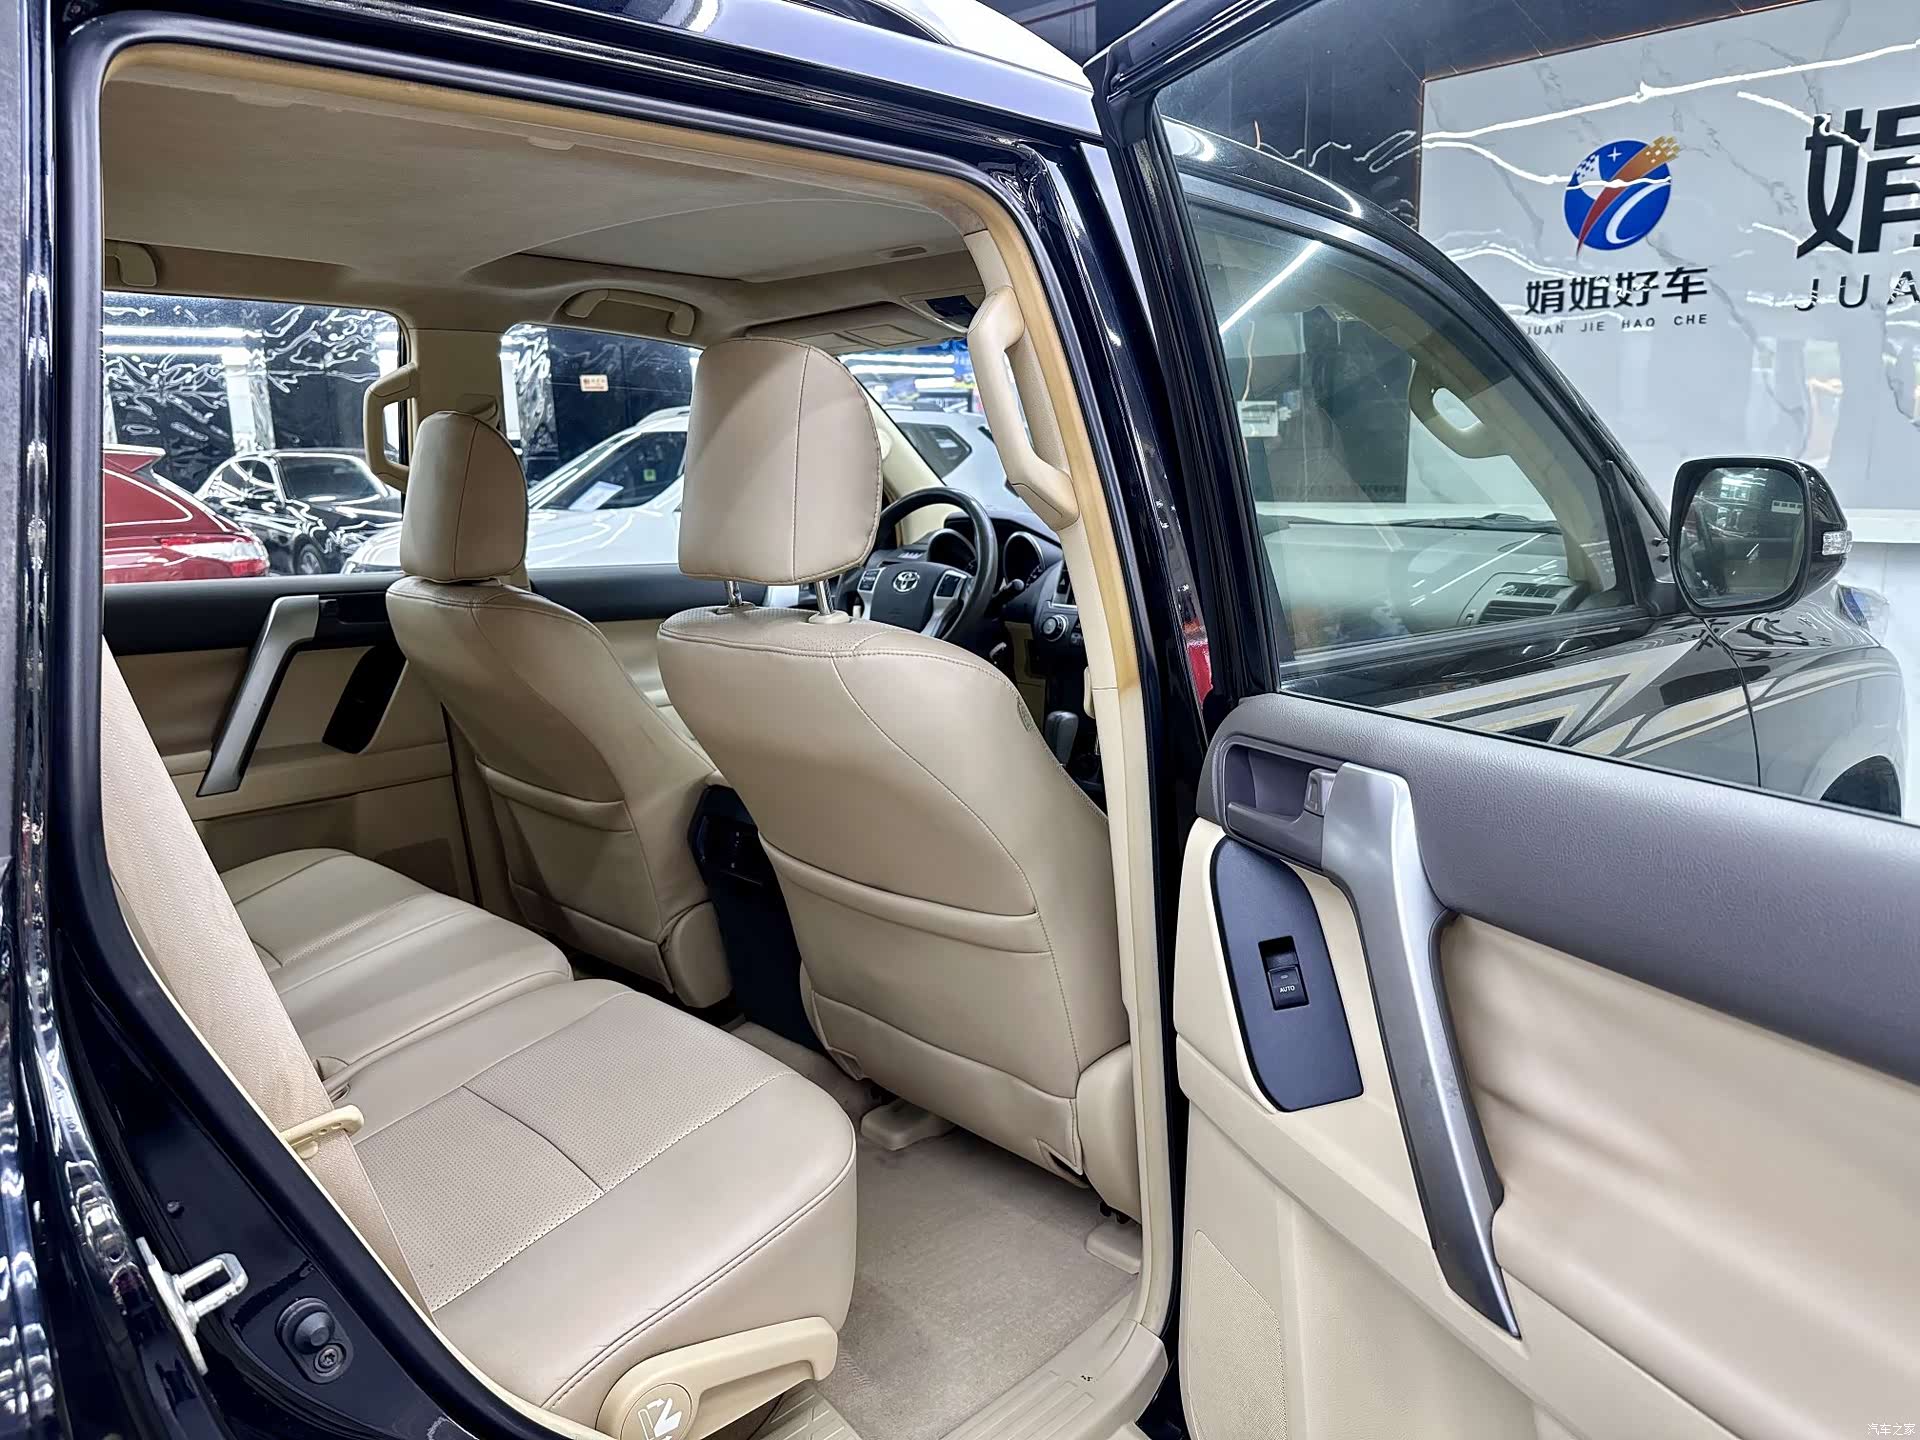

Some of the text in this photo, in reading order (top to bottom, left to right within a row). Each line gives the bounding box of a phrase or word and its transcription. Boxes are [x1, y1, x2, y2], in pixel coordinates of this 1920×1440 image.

[1525, 267, 1708, 315] 娟姐好车
[1527, 314, 1708, 336] JUAN JIE HAO CHE
[1280, 985, 1296, 993] AUTO
